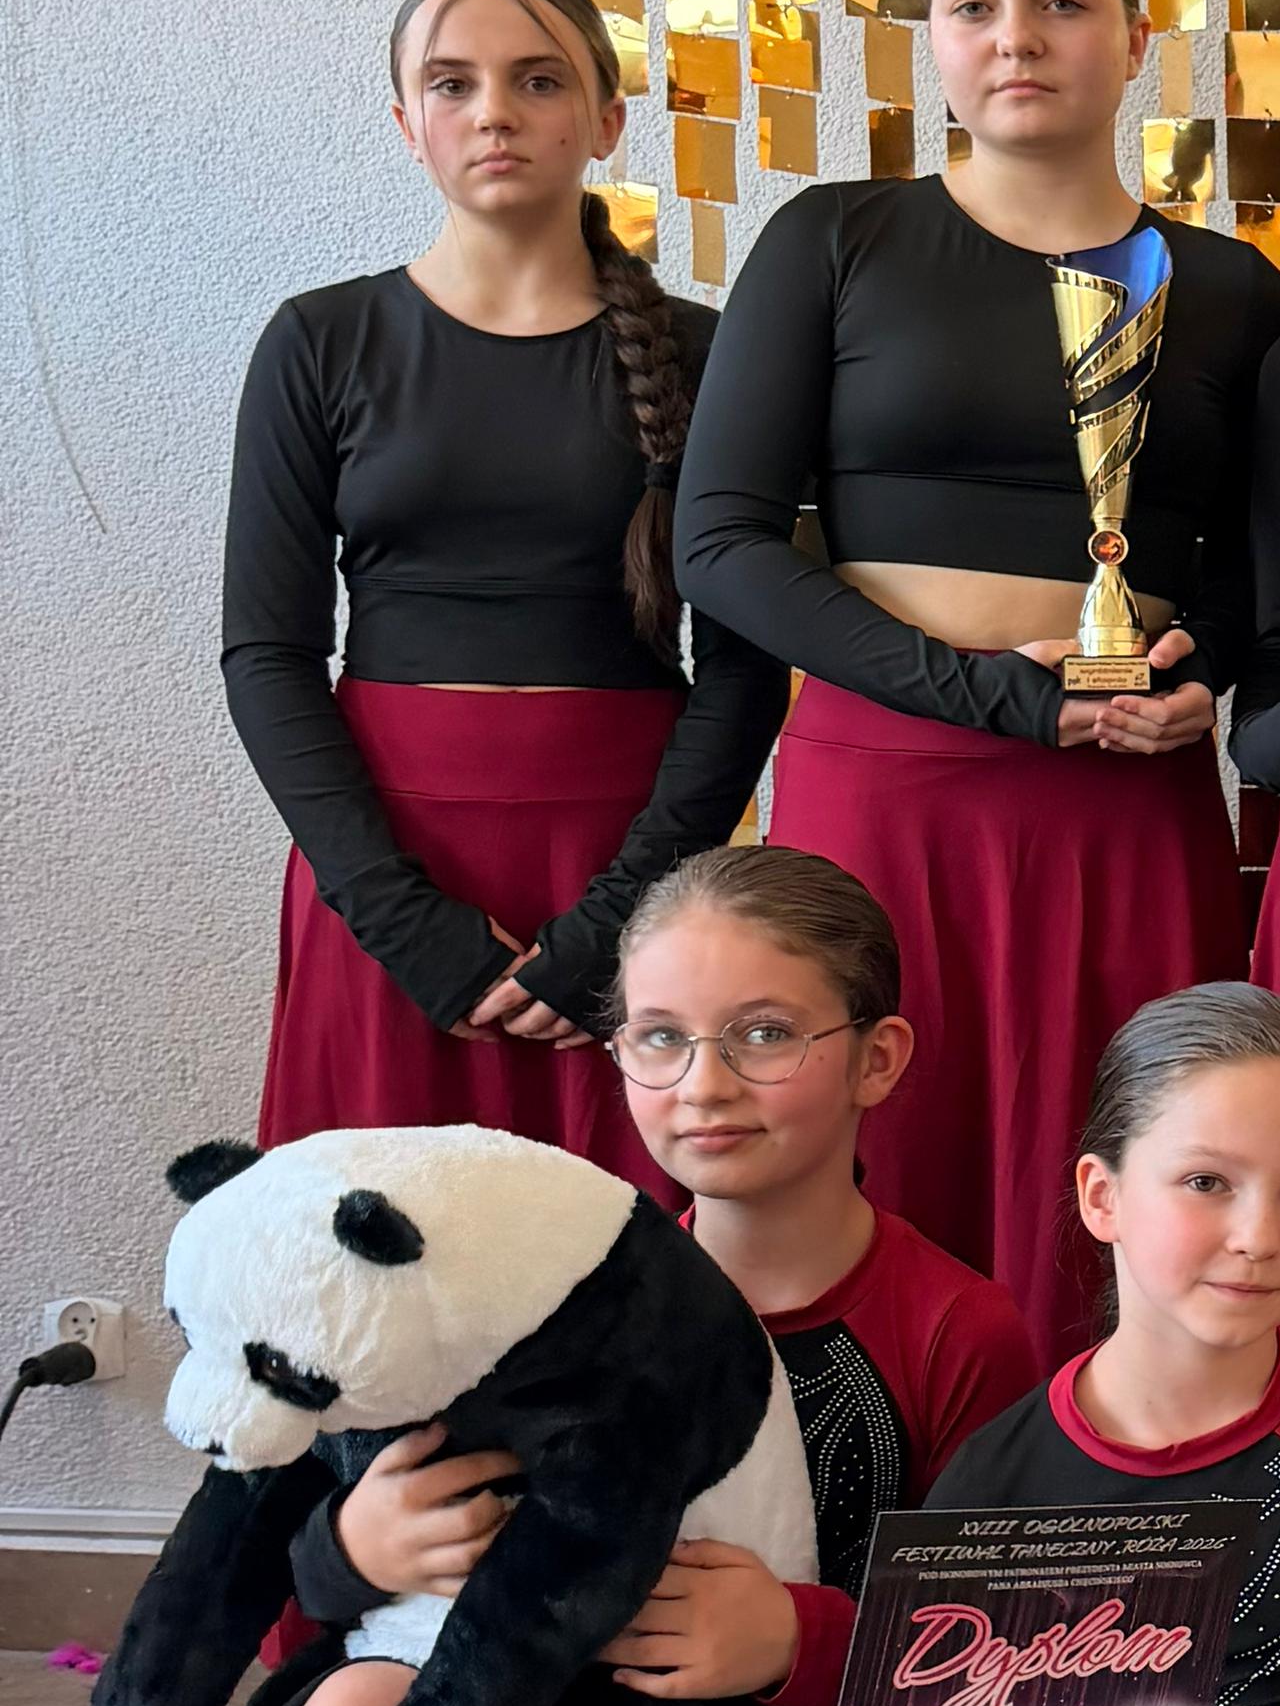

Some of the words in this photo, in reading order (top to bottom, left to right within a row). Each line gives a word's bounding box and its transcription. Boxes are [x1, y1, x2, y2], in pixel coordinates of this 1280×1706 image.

[958, 1520, 1019, 1536] XVIII
[1023, 1513, 1191, 1536] OGÓLNOPOLSKI
[891, 1544, 1004, 1563] FESTIWAL
[1008, 1540, 1115, 1561] TANECZNY
